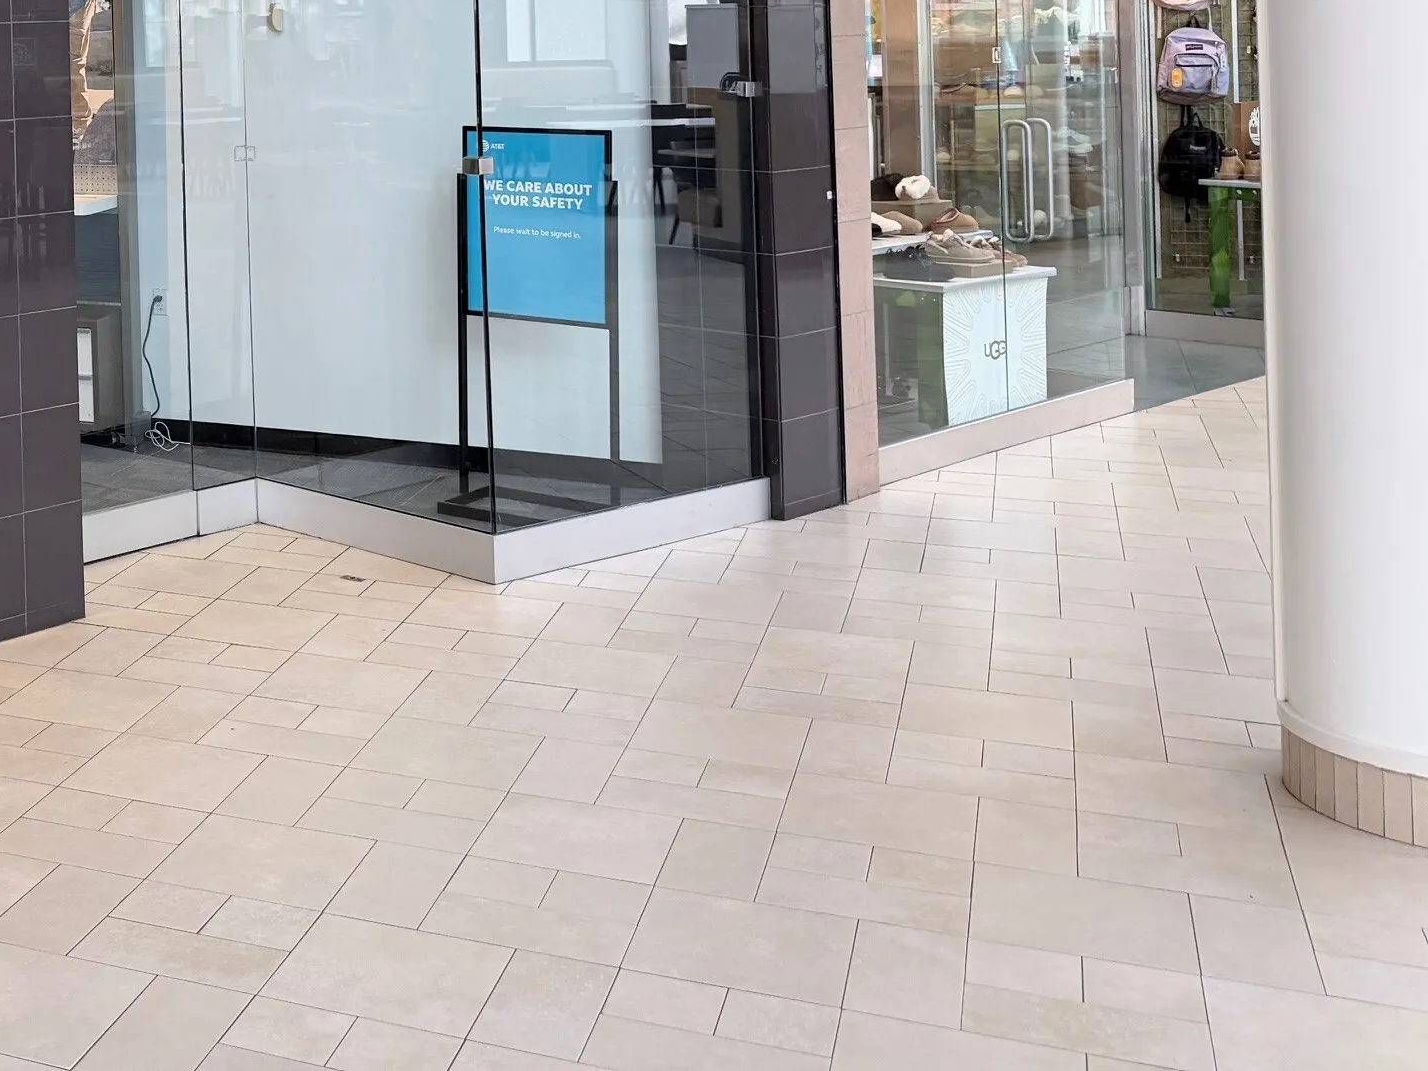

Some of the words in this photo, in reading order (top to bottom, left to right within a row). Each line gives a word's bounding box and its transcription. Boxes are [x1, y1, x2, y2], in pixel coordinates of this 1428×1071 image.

[484, 179, 504, 192] WE
[506, 180, 542, 194] CARE
[544, 182, 592, 197] ABOUT
[492, 193, 529, 207] YOUR
[532, 196, 584, 210] SAFETY
[493, 226, 515, 235] Please
[515, 228, 531, 236] wait
[540, 229, 550, 237] be
[550, 231, 572, 239] signed
[573, 231, 582, 239] in.
